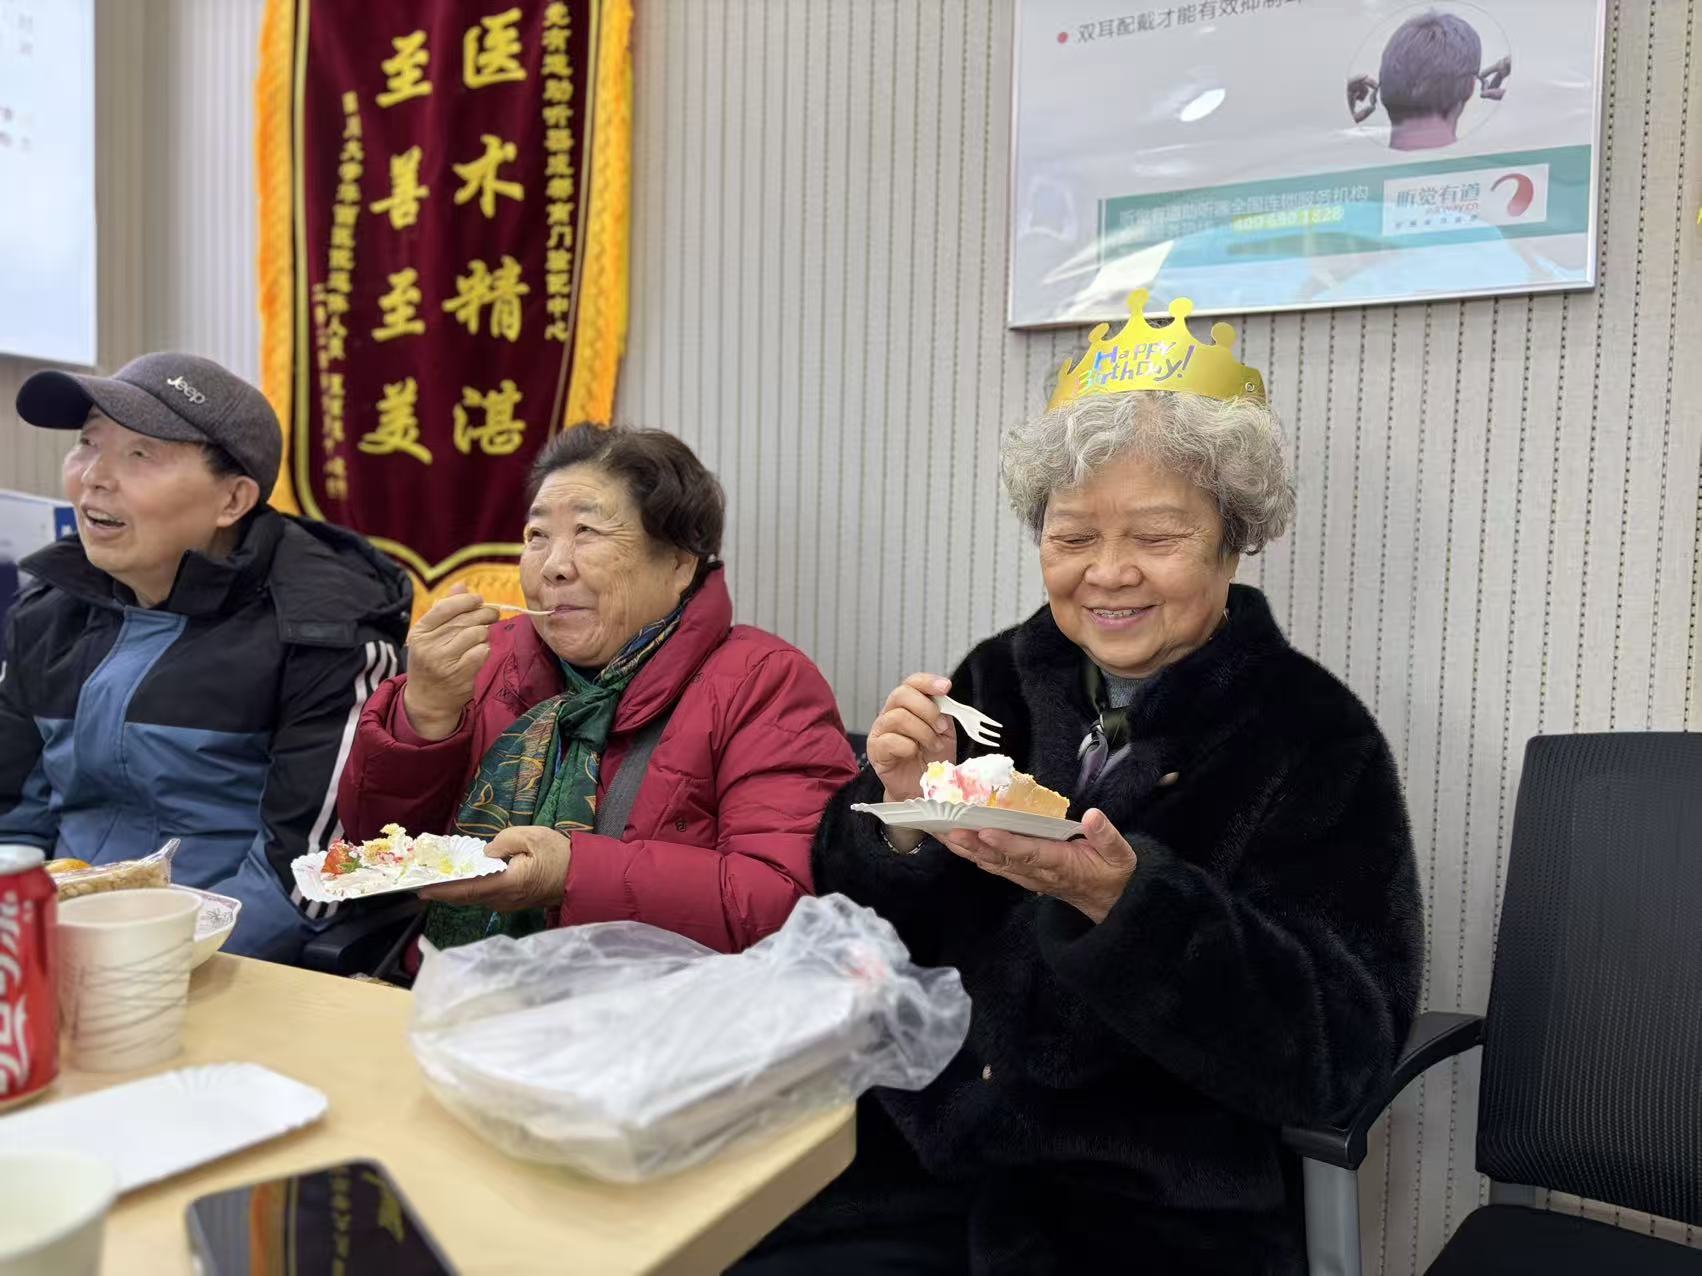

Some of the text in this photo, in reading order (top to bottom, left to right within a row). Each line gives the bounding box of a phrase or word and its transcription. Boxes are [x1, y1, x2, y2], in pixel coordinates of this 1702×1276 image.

[167, 376, 206, 404] Jeep
[358, 30, 433, 465] 至善至美
[442, 8, 530, 456] 医术精湛
